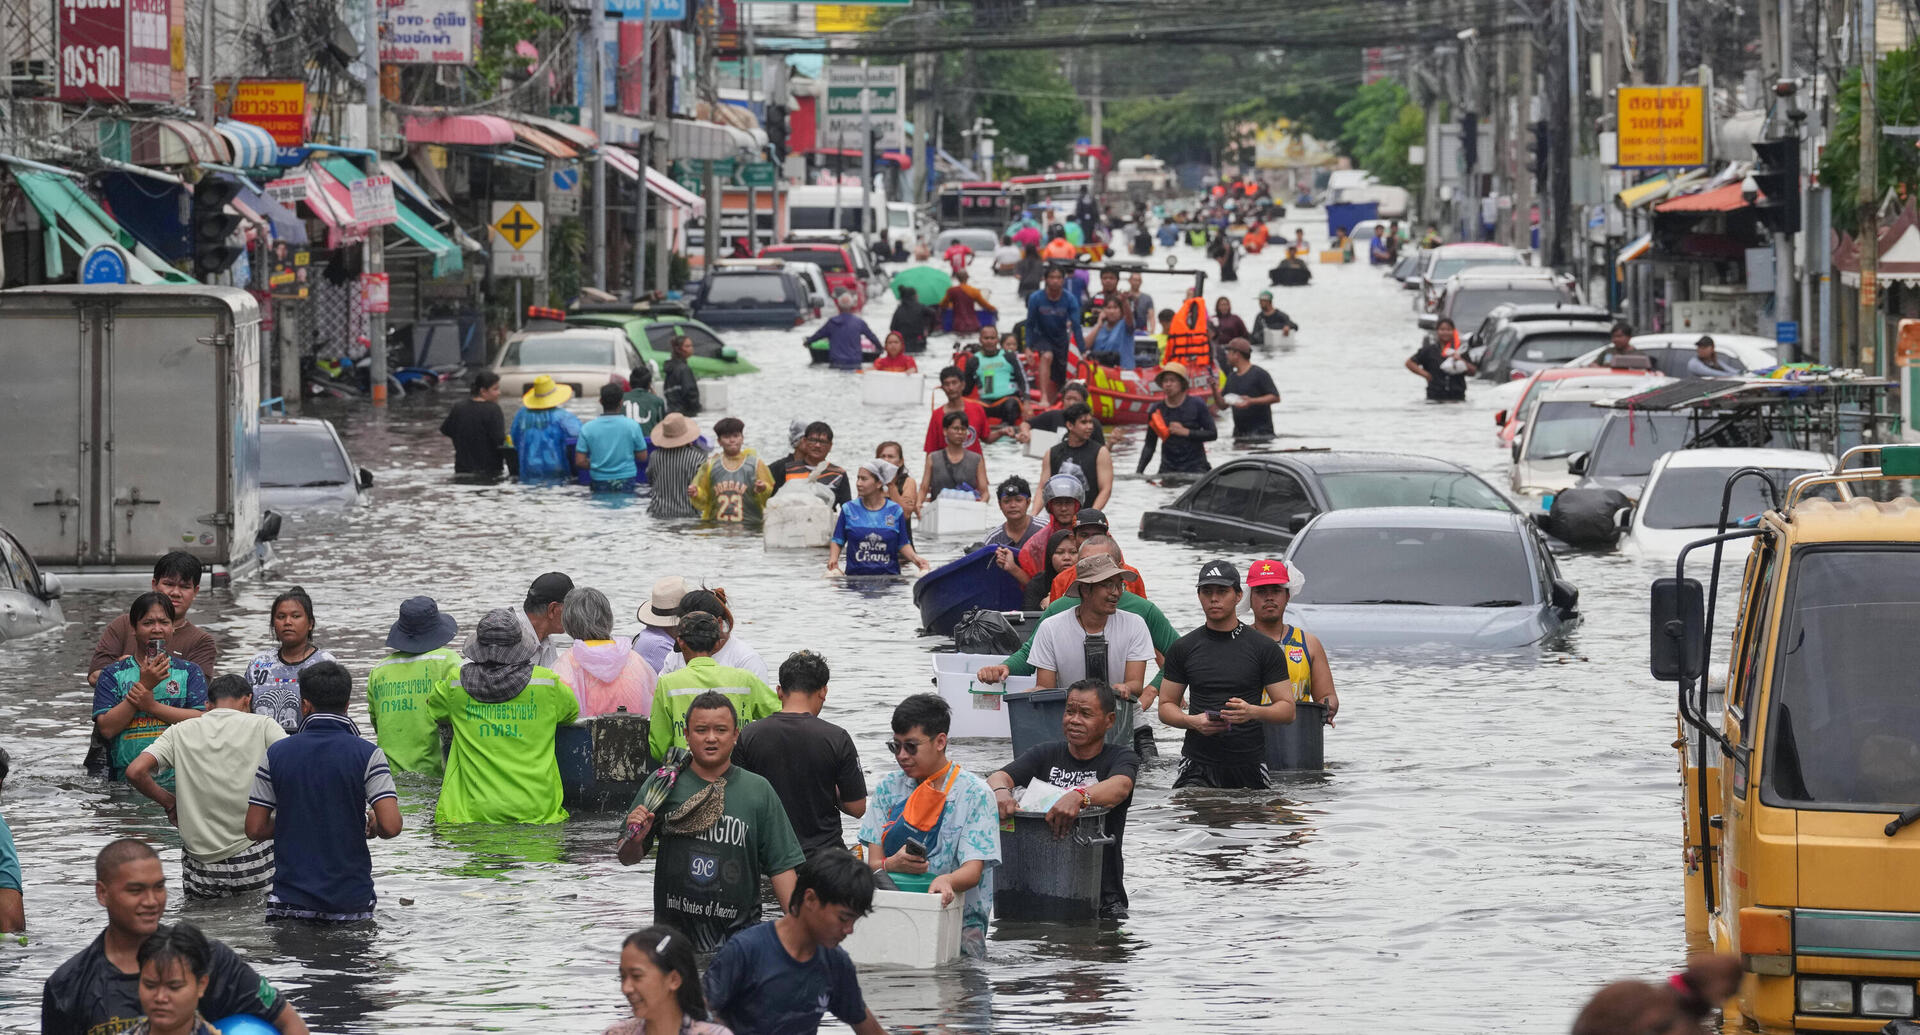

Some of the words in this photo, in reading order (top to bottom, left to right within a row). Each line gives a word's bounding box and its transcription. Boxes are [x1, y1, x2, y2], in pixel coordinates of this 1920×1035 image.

[63, 45, 120, 88] กระจก
[1629, 91, 1690, 110] สอนขับ
[1629, 112, 1684, 129] รถยนต์
[713, 480, 748, 496] JORDAN
[716, 494, 744, 522] 23
[855, 550, 891, 565] Chang
[252, 669, 269, 686] 30
[381, 697, 417, 713] กทม.
[466, 690, 538, 721] สำนกการระบายน้ำ
[479, 722, 523, 737] กทม.
[1049, 766, 1077, 781] Enjoy
[691, 857, 715, 878] DC
[682, 897, 703, 915] States
[705, 901, 714, 917] of
[714, 902, 739, 919] America
